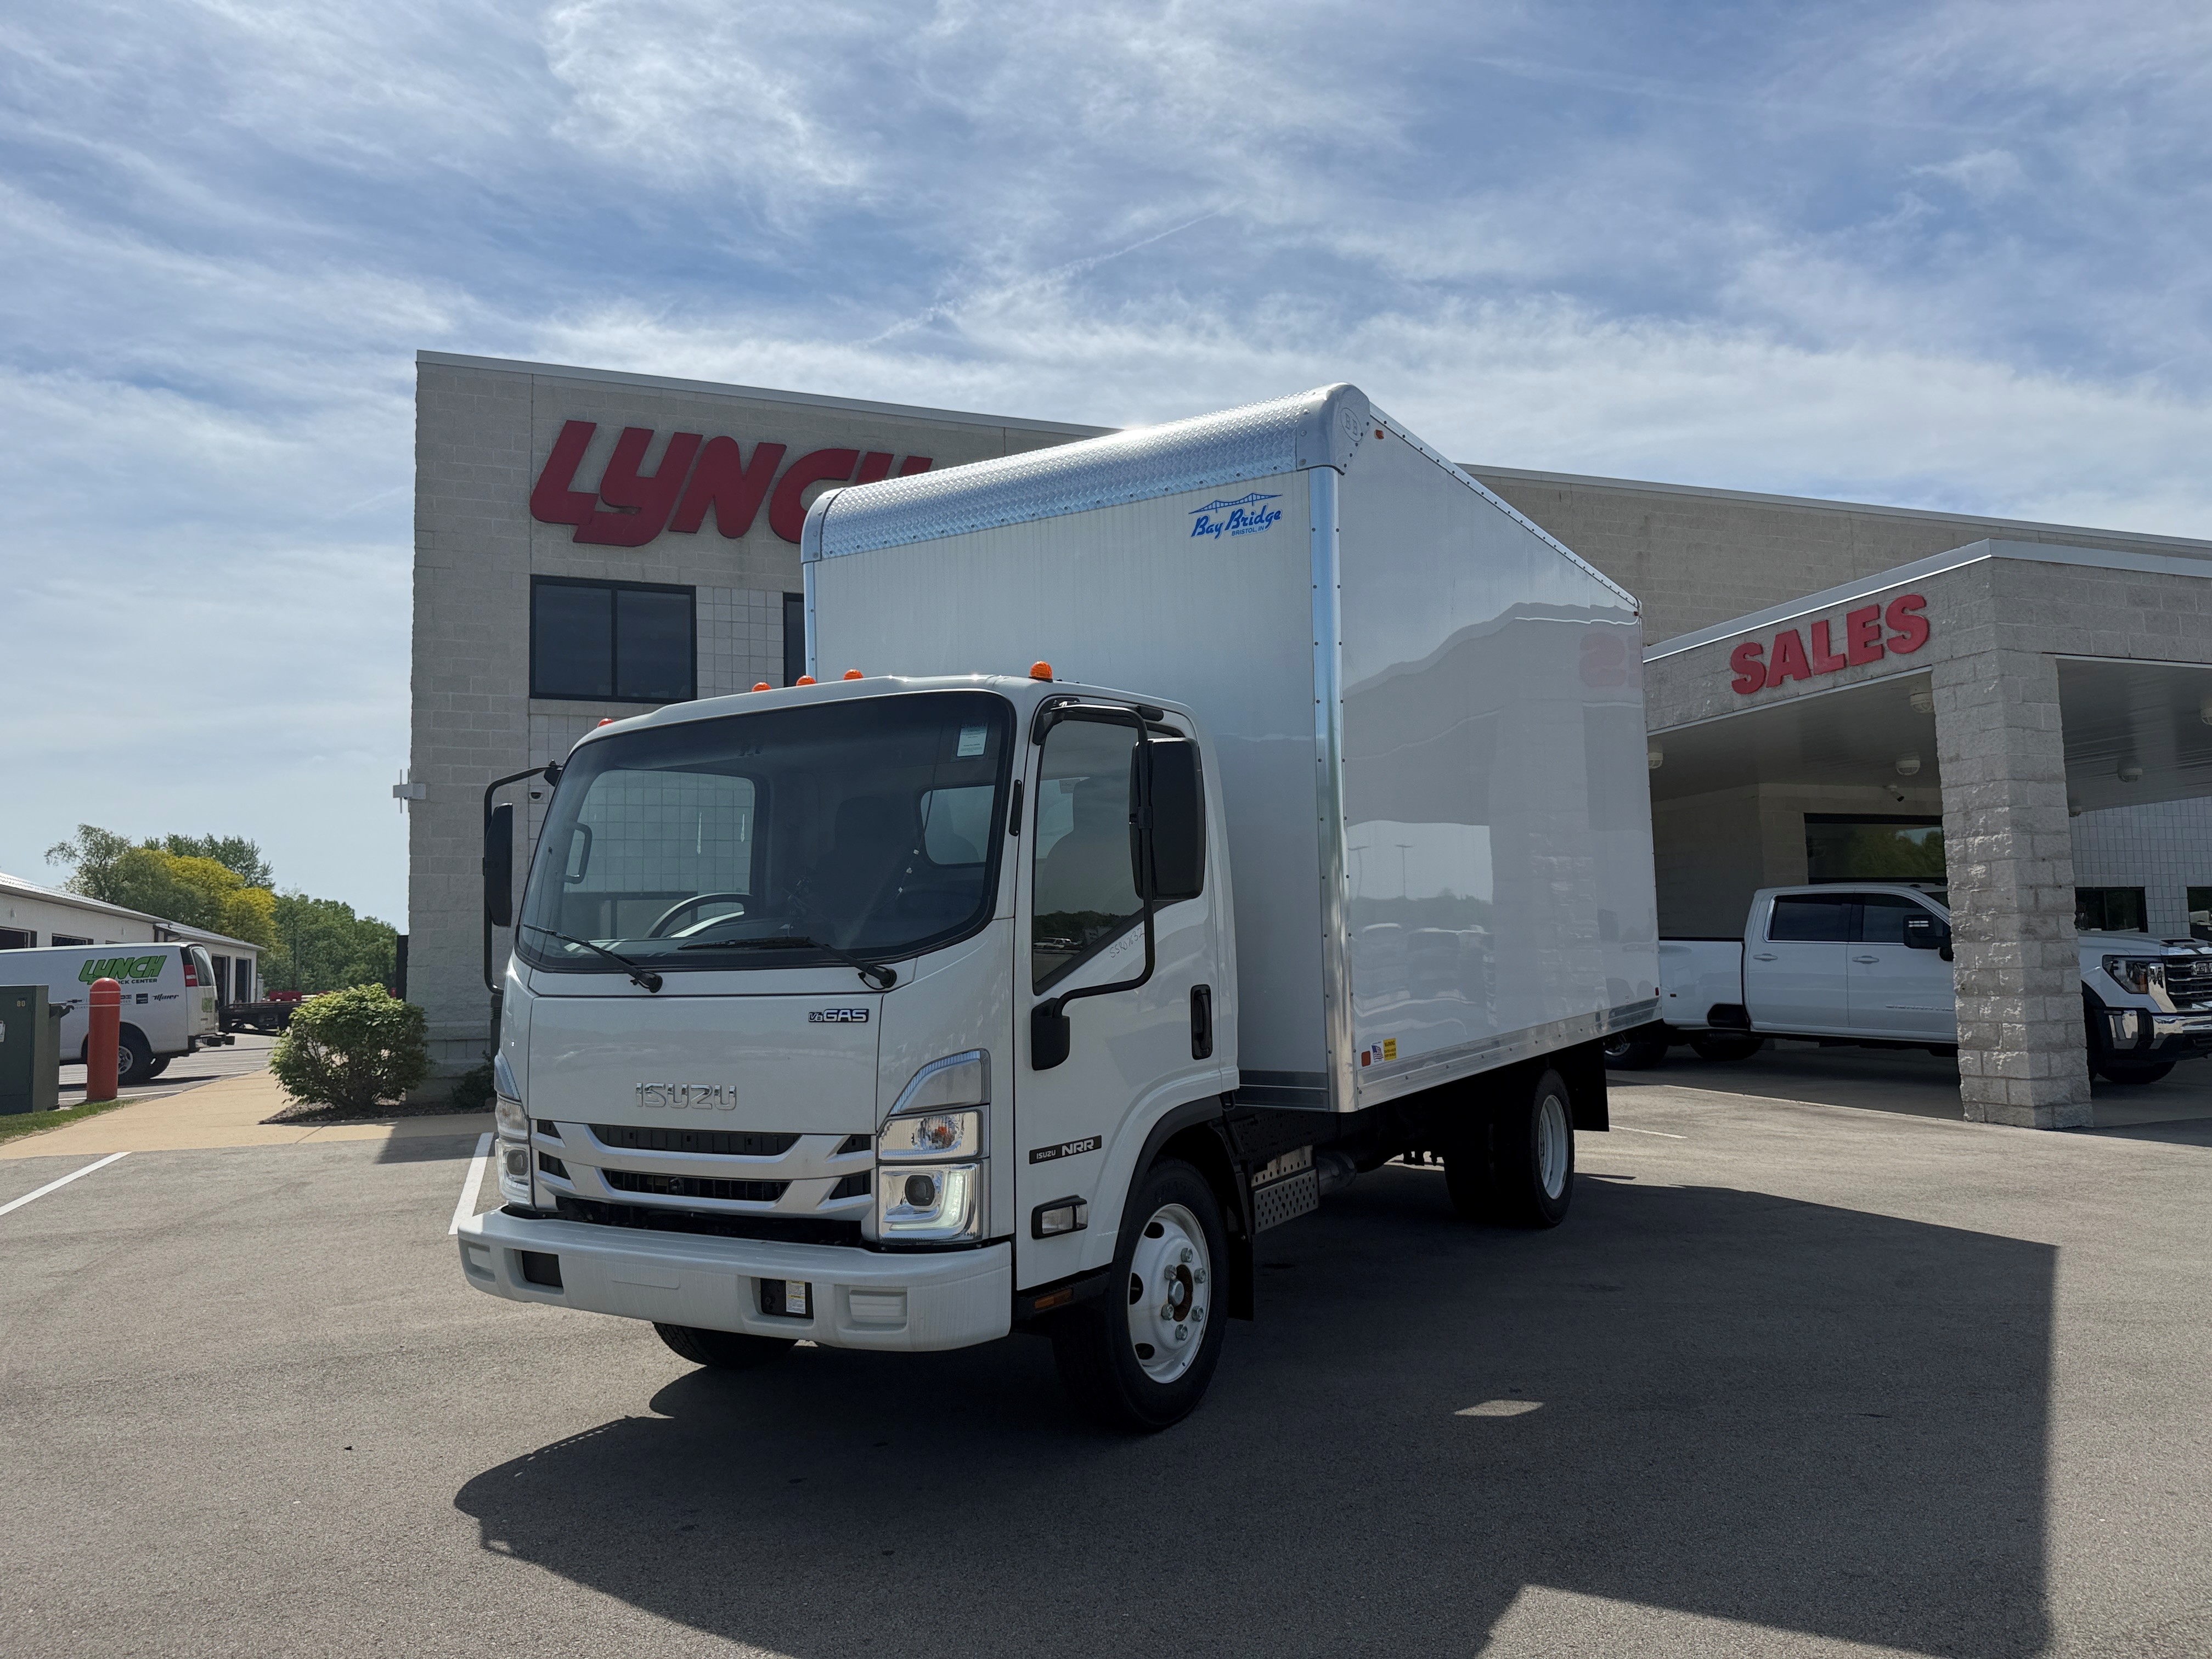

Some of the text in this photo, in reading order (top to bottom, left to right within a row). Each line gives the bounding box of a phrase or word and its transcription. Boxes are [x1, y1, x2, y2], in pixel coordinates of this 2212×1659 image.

[1191, 505, 1282, 539] Bay Bridge
[1730, 594, 1929, 695] SALES
[78, 955, 167, 985] LYNCH
[636, 1082, 737, 1111] ISUZU
[1036, 1139, 1094, 1160] ISUZU NRR
